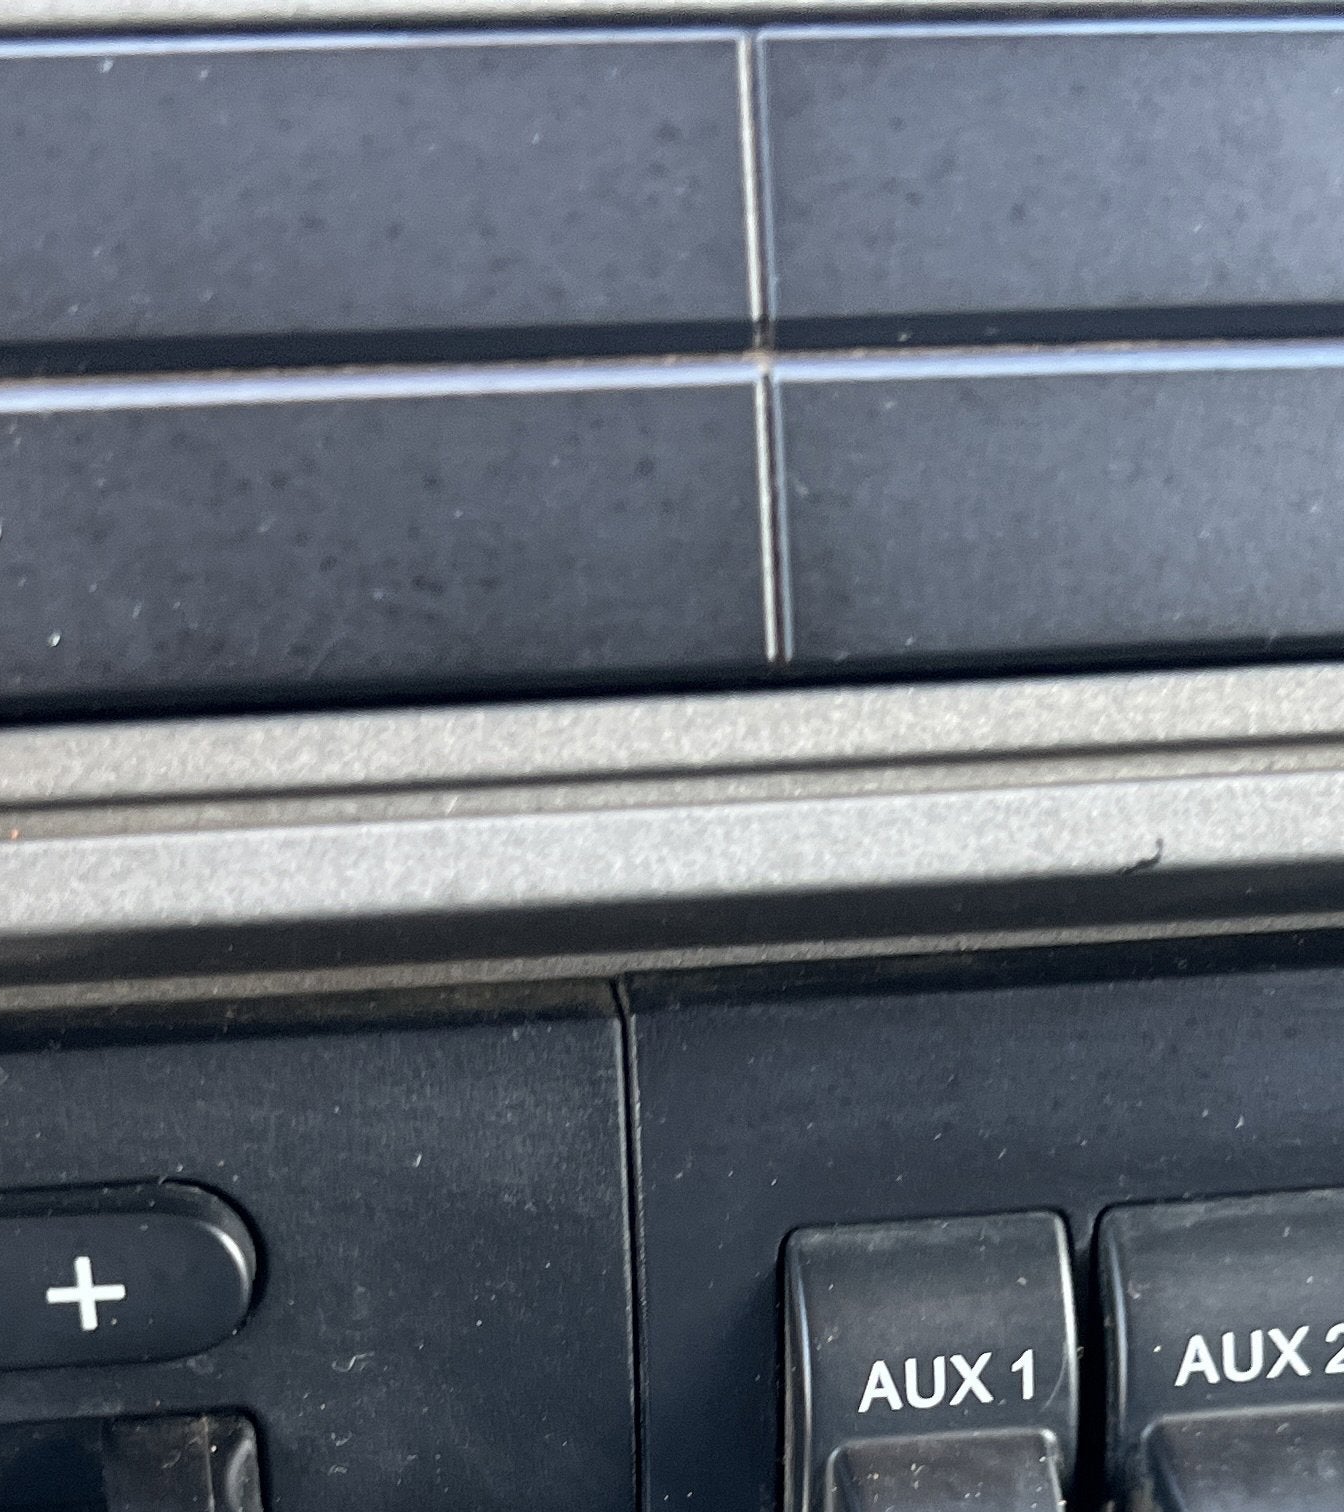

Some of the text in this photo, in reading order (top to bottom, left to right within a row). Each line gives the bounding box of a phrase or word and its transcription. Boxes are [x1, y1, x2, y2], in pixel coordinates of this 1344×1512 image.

[857, 1348, 1036, 1413] AUX 1
[1174, 1324, 1312, 1387] AUX
